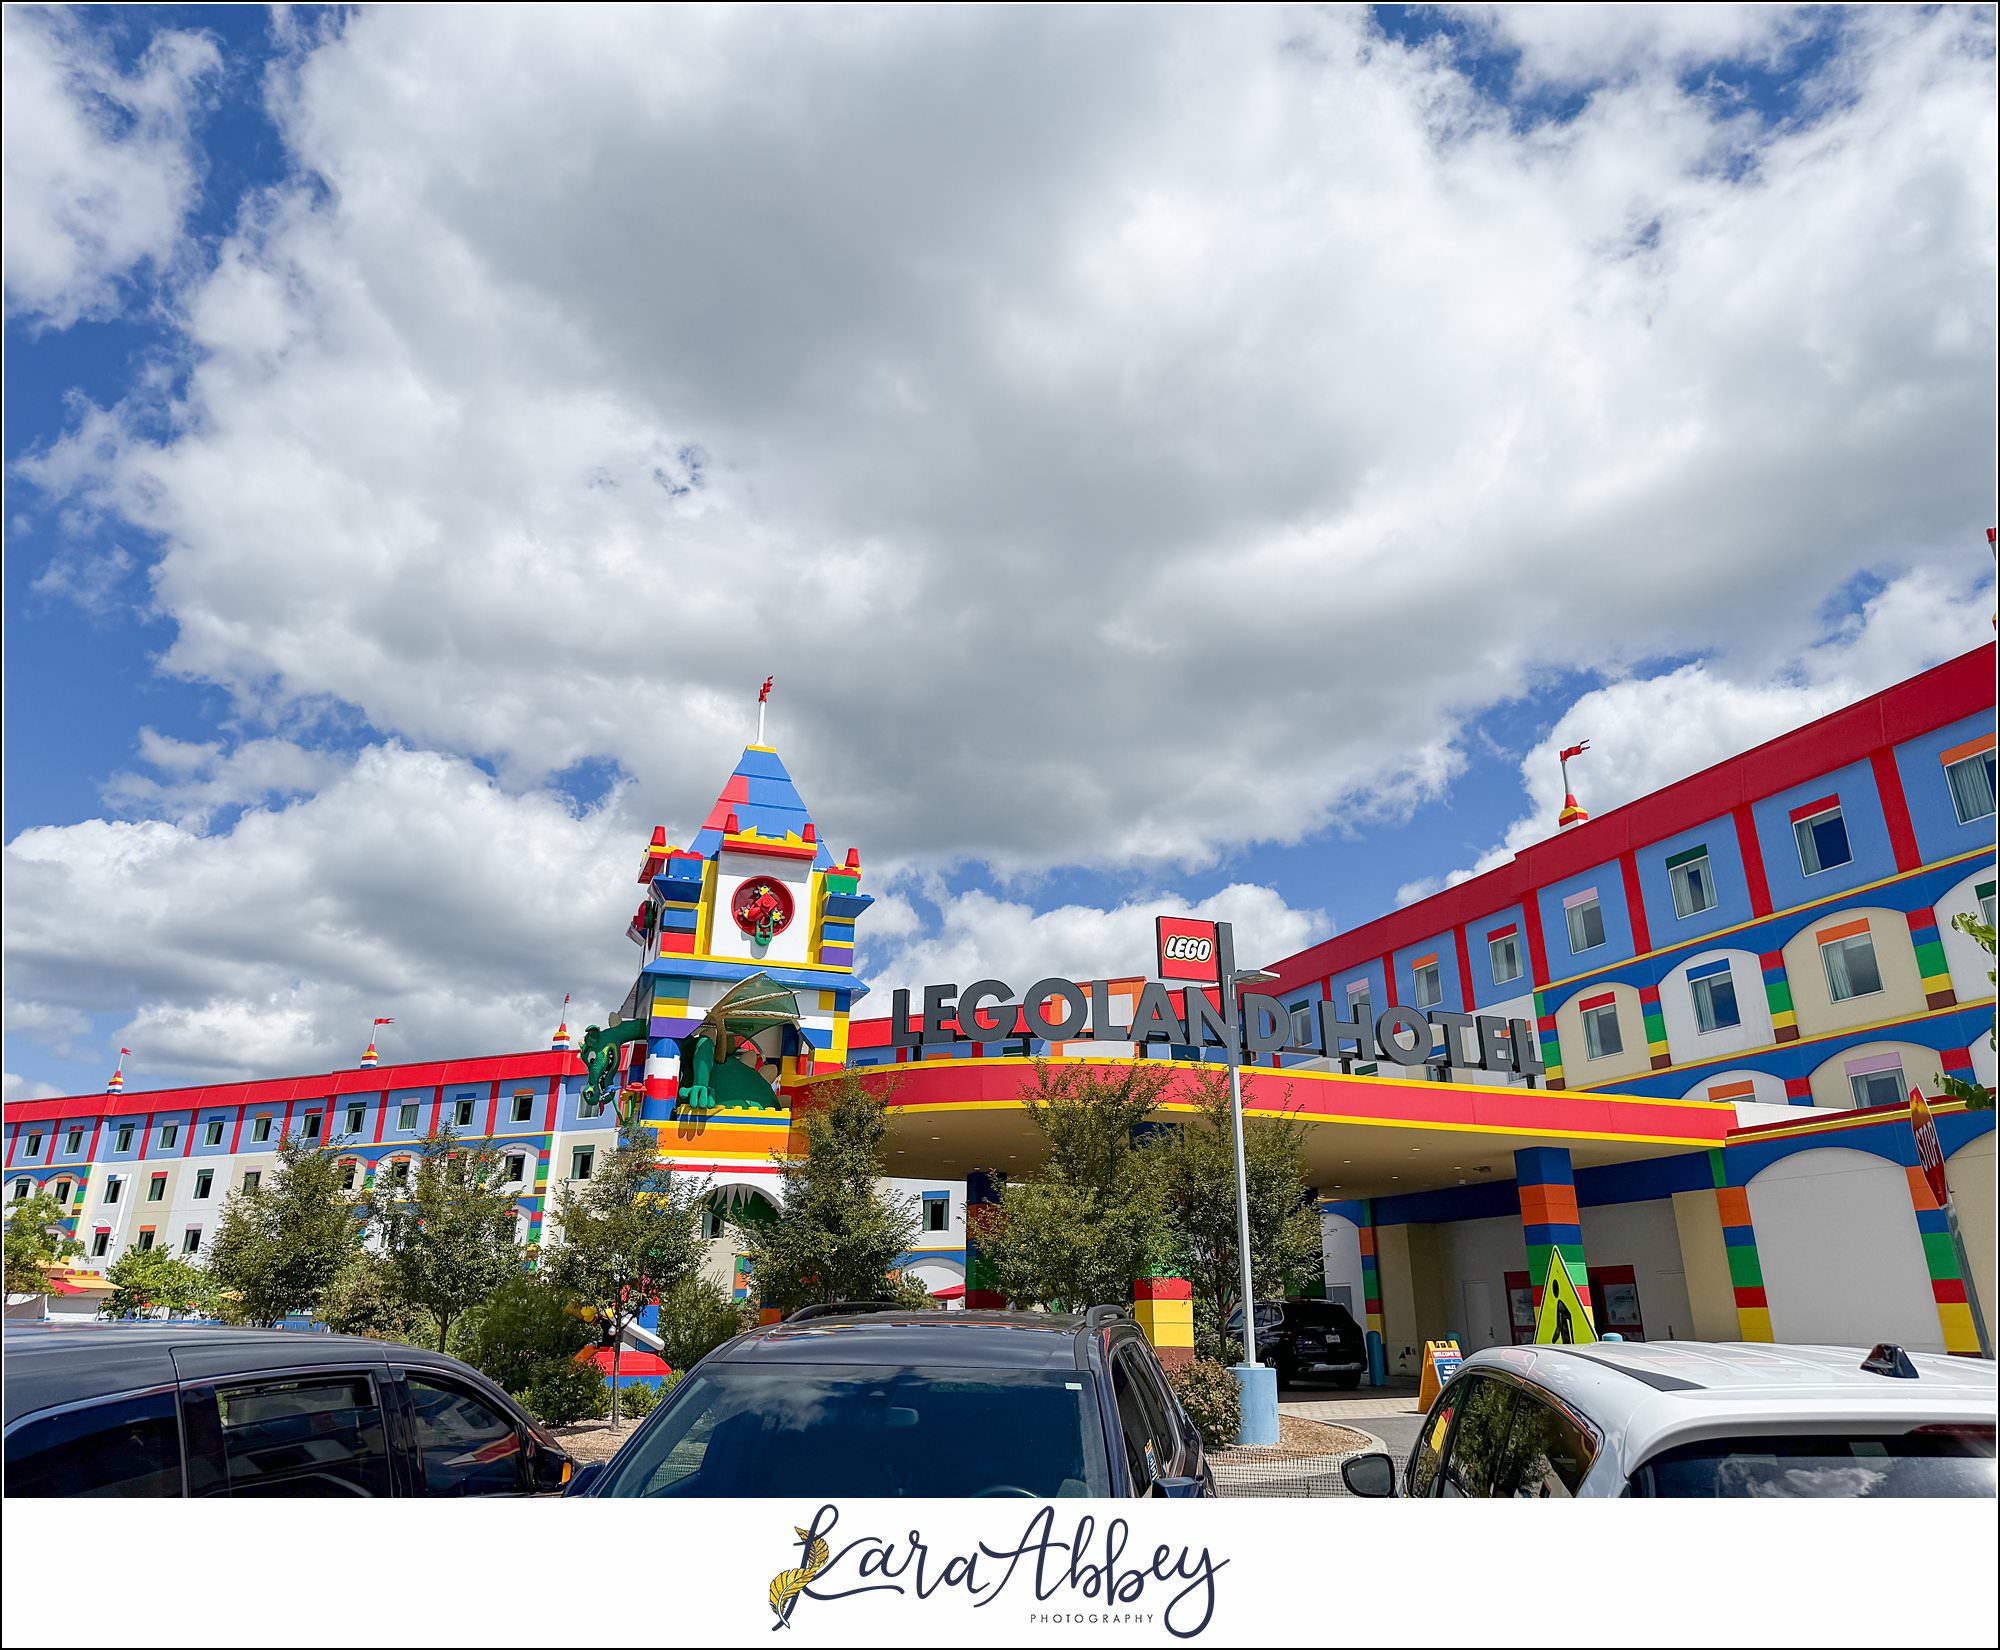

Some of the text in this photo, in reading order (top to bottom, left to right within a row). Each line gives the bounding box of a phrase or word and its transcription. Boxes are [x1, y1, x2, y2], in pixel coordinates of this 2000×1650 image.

[1165, 935, 1211, 961] LEGO
[891, 977, 1546, 1076] LEGOLAND HOTEL
[1916, 1120, 1940, 1172] STOP
